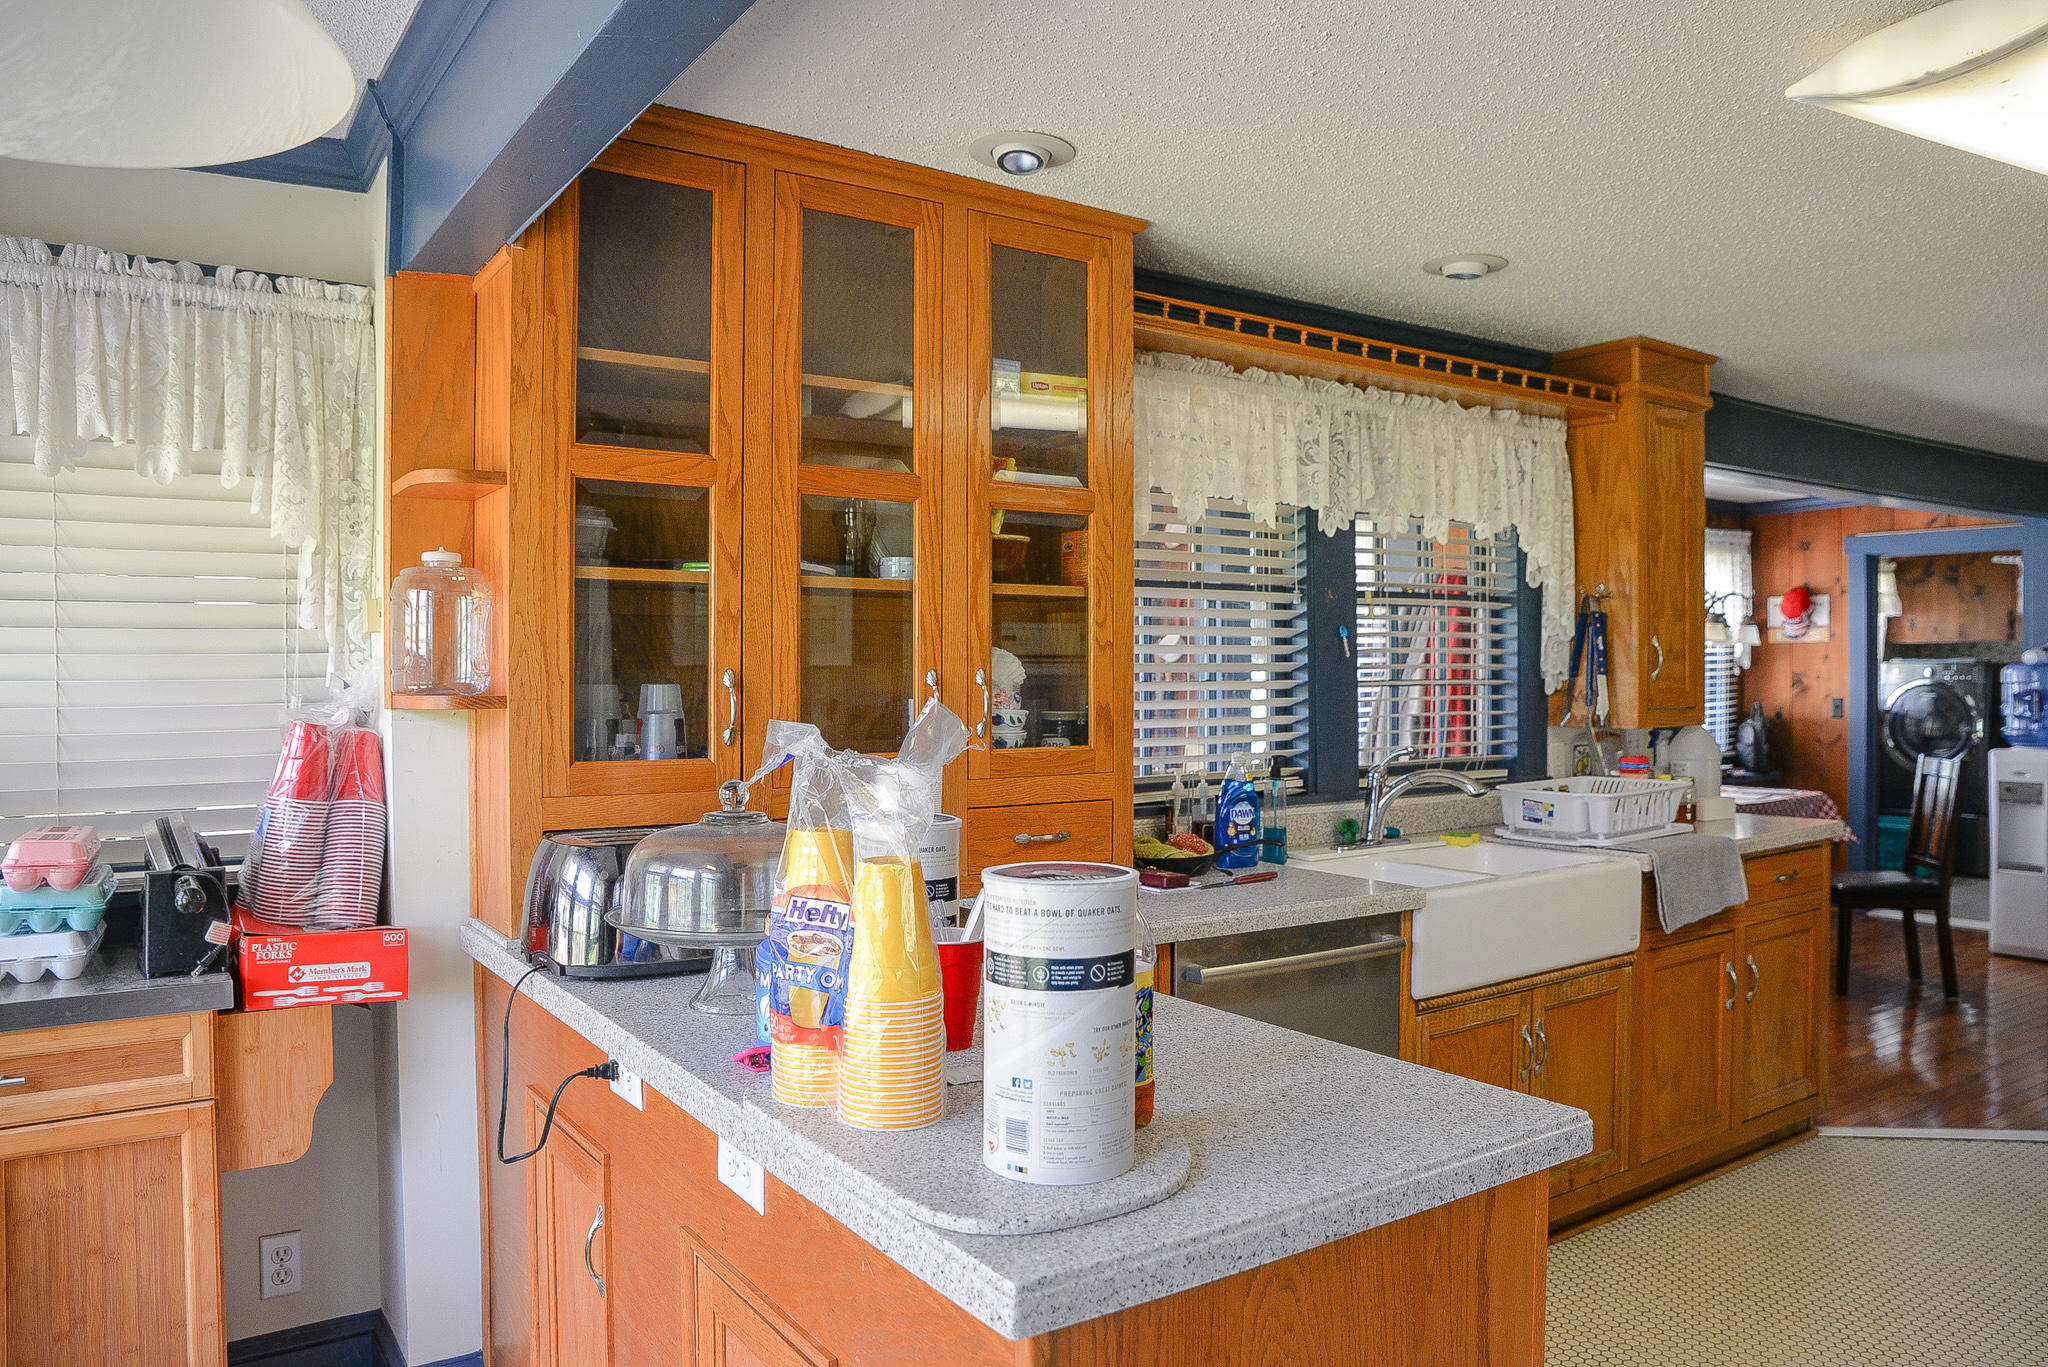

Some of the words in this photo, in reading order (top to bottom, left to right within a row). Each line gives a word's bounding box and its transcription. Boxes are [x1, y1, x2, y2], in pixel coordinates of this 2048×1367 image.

[1230, 808, 1256, 819] DAWN
[788, 899, 848, 931] Hefty
[1006, 905, 1013, 914] TO
[1015, 907, 1031, 916] BEAT
[1033, 908, 1039, 917] A
[1040, 909, 1062, 918] BOWL
[1065, 909, 1075, 918] OF
[1077, 907, 1105, 918] QUAKER
[1106, 905, 1121, 915] OATS
[384, 933, 404, 942] 600
[251, 942, 298, 953] PLASTIC
[256, 951, 293, 960] FORKS
[308, 966, 346, 976] Member's
[346, 965, 367, 973] Mark
[771, 962, 817, 984] PARTY
